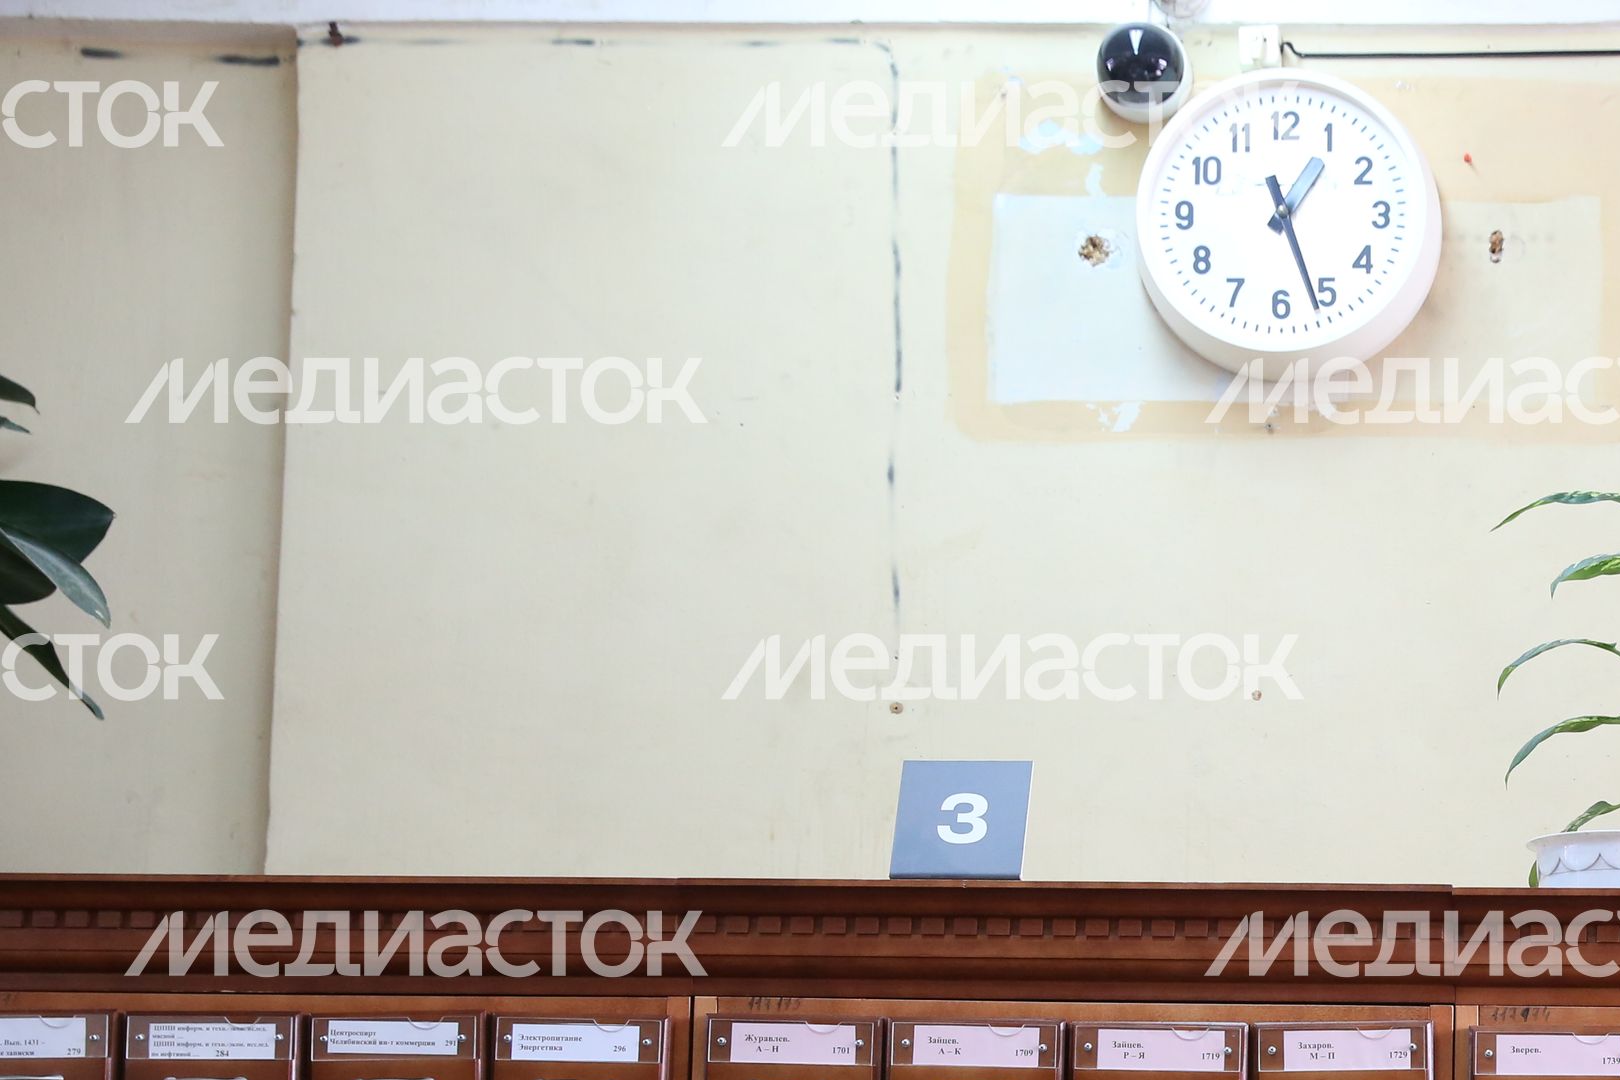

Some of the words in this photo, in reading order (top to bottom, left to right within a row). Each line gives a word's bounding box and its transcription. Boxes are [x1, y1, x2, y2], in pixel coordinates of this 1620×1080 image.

[1229, 123, 1250, 152] 11
[1271, 111, 1300, 141] 12
[1324, 123, 1333, 152] 1
[1192, 156, 1222, 185] 10
[1354, 157, 1373, 185] 2
[1175, 201, 1194, 229] 9
[1372, 201, 1391, 229] 3
[1193, 245, 1211, 274] 8
[1352, 245, 1373, 274] 4
[1226, 278, 1245, 307] 7
[1272, 290, 1291, 319] 6
[1317, 278, 1337, 307] 5
[937, 792, 989, 845] 3
[518, 1034, 582, 1043] Электропитание
[518, 1043, 563, 1052] Энергетика
[745, 1034, 790, 1044] Журавлев.
[833, 1047, 850, 1055] 1701
[928, 1036, 959, 1044] Зайцев.
[1298, 1042, 1334, 1051] Захаров.
[1511, 1046, 1542, 1055] Зверев.
[1389, 1051, 1408, 1059] 1729
